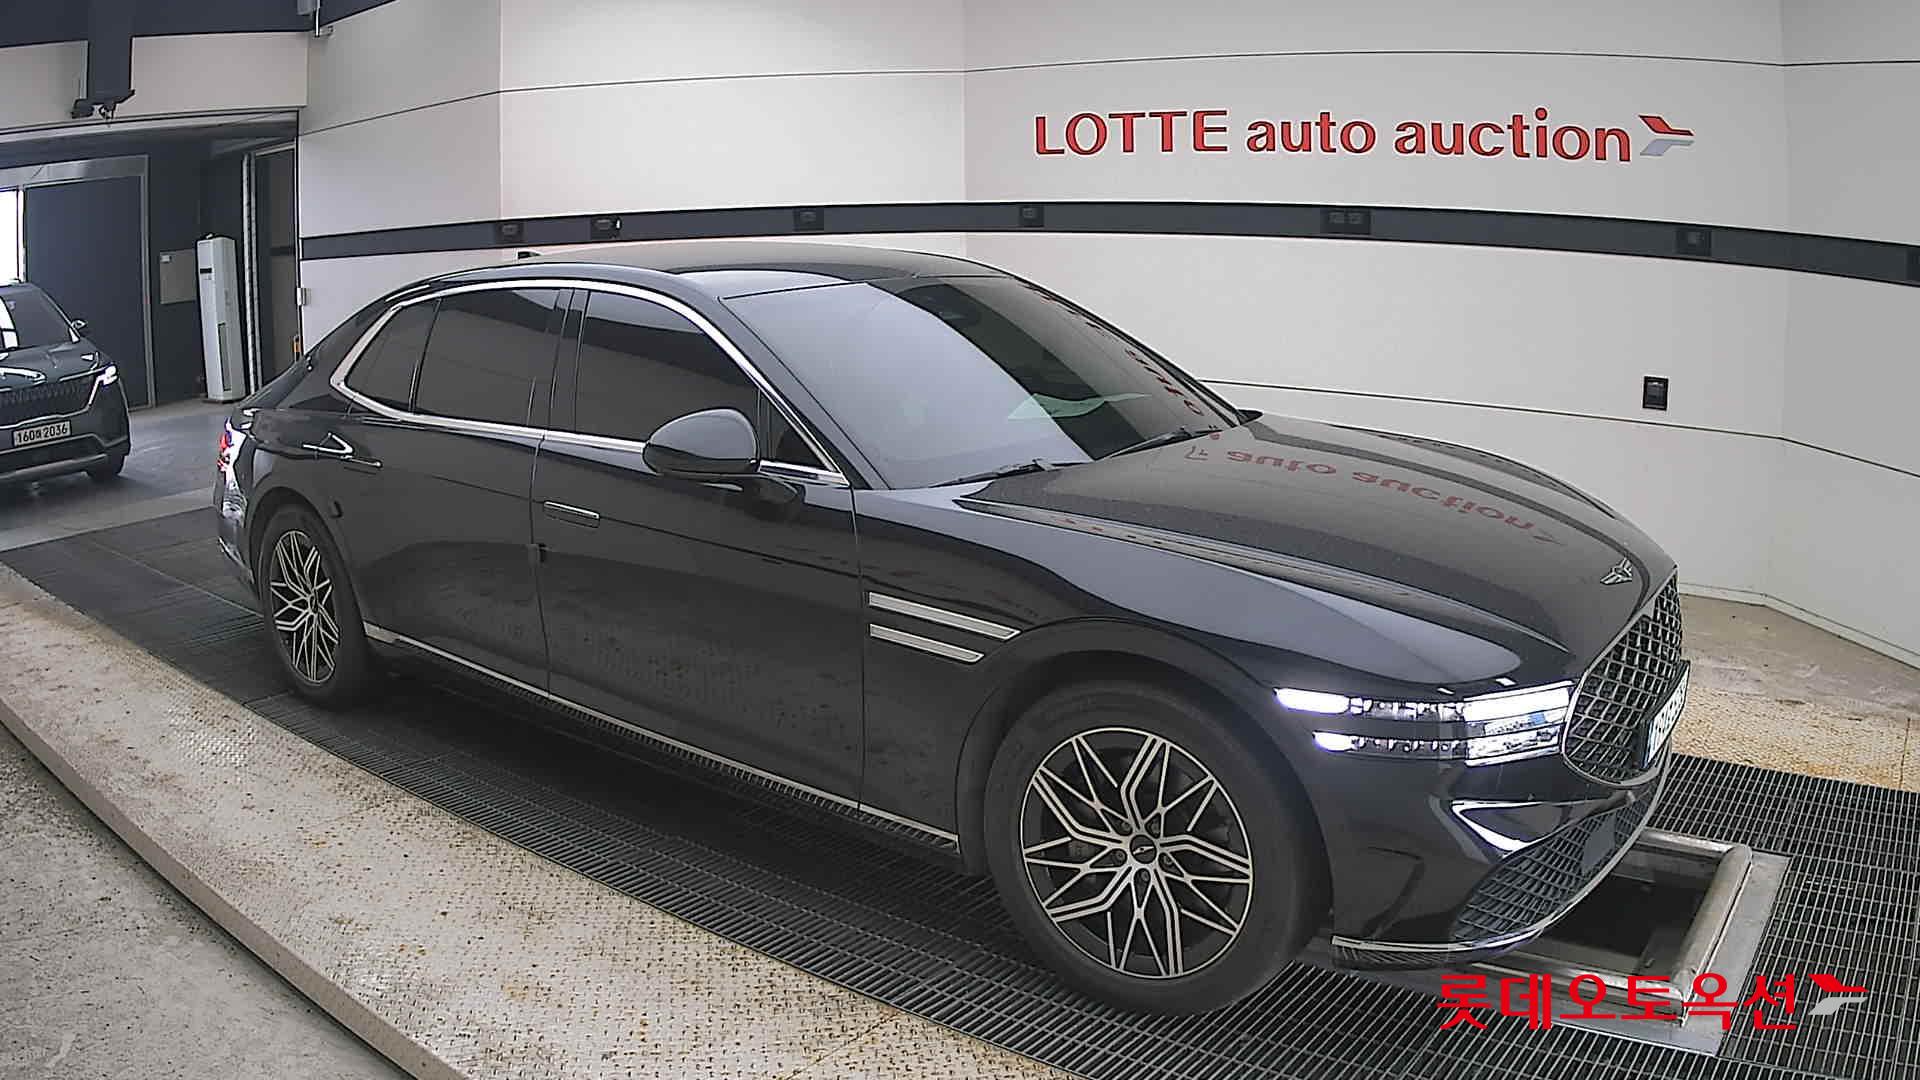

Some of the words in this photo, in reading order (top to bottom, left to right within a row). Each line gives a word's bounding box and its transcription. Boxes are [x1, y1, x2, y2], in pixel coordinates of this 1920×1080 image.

[1035, 110, 1228, 155] LOTTE
[1247, 111, 1376, 154] auto
[1394, 107, 1631, 162] auction
